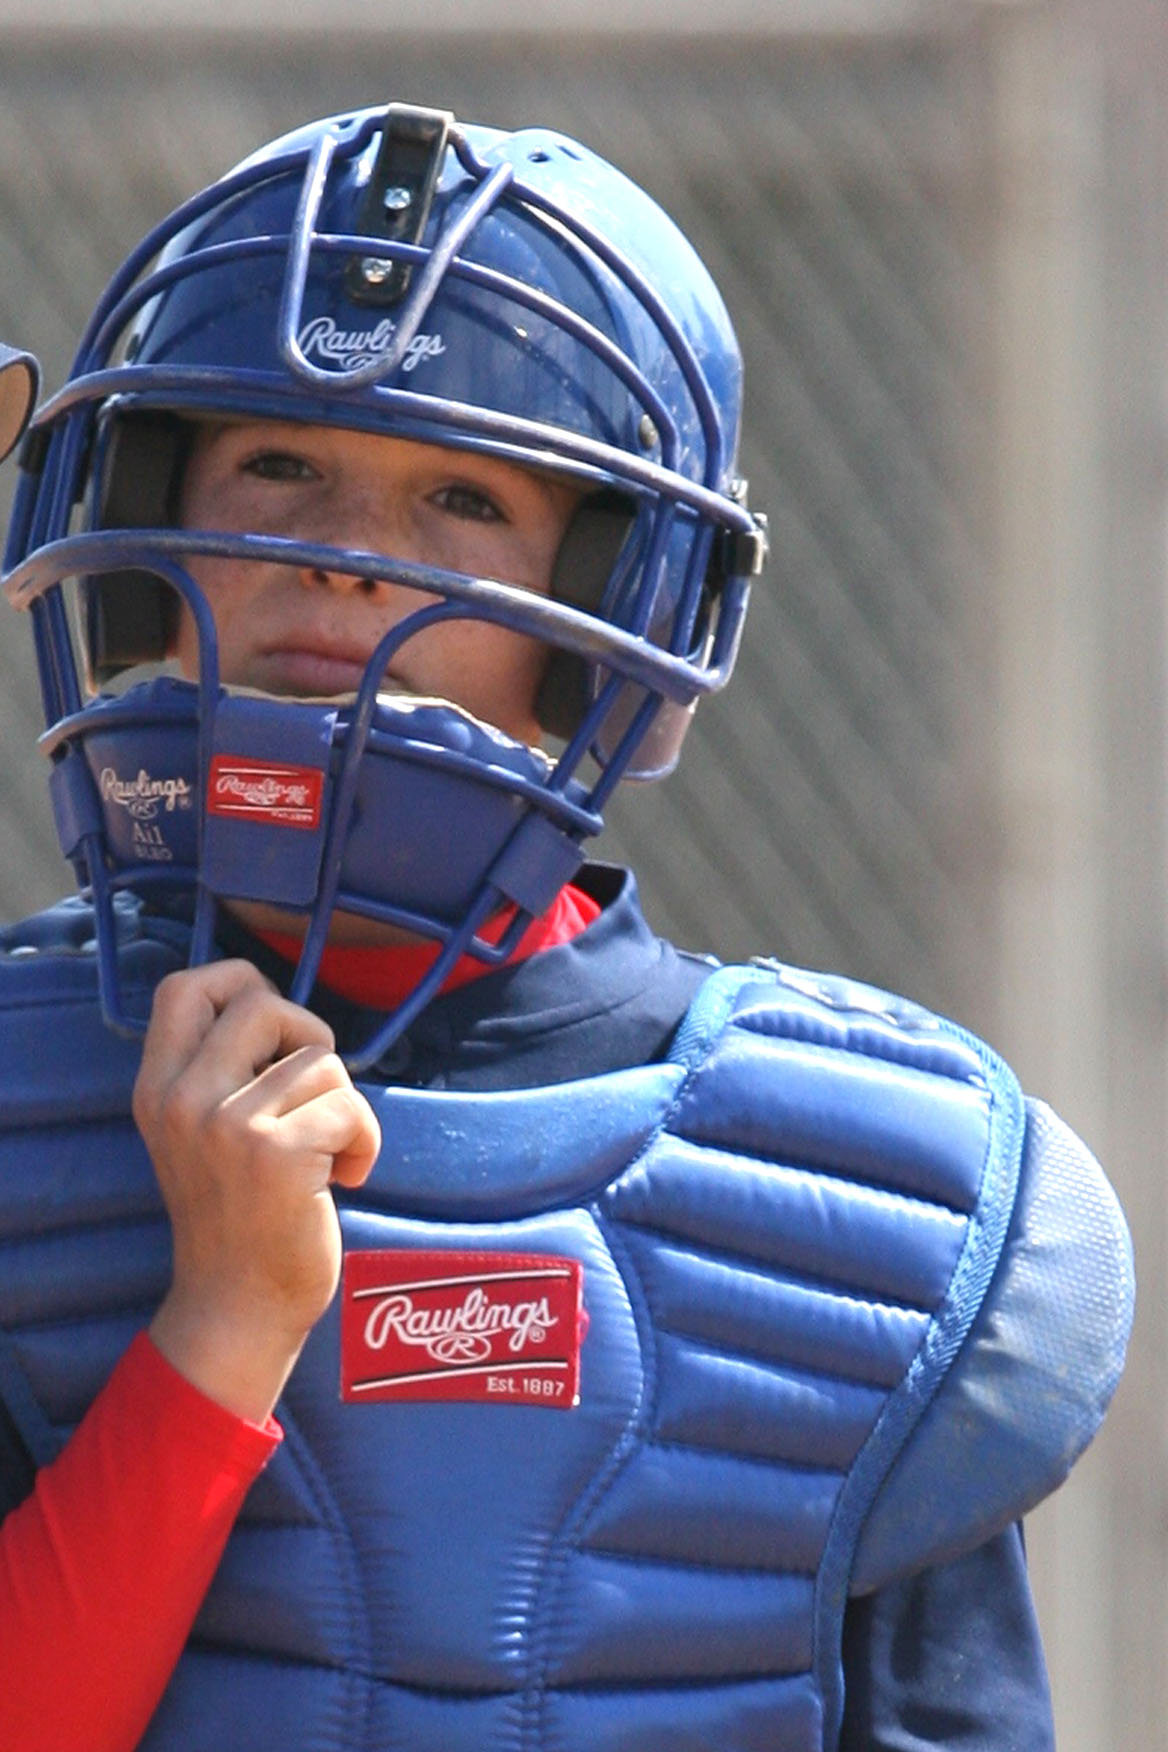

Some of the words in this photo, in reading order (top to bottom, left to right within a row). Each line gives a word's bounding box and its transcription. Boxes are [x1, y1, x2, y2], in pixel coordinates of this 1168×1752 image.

[298, 317, 447, 372] Rawligs
[101, 767, 191, 812] Rawlings
[364, 1287, 559, 1352] Rawlings
